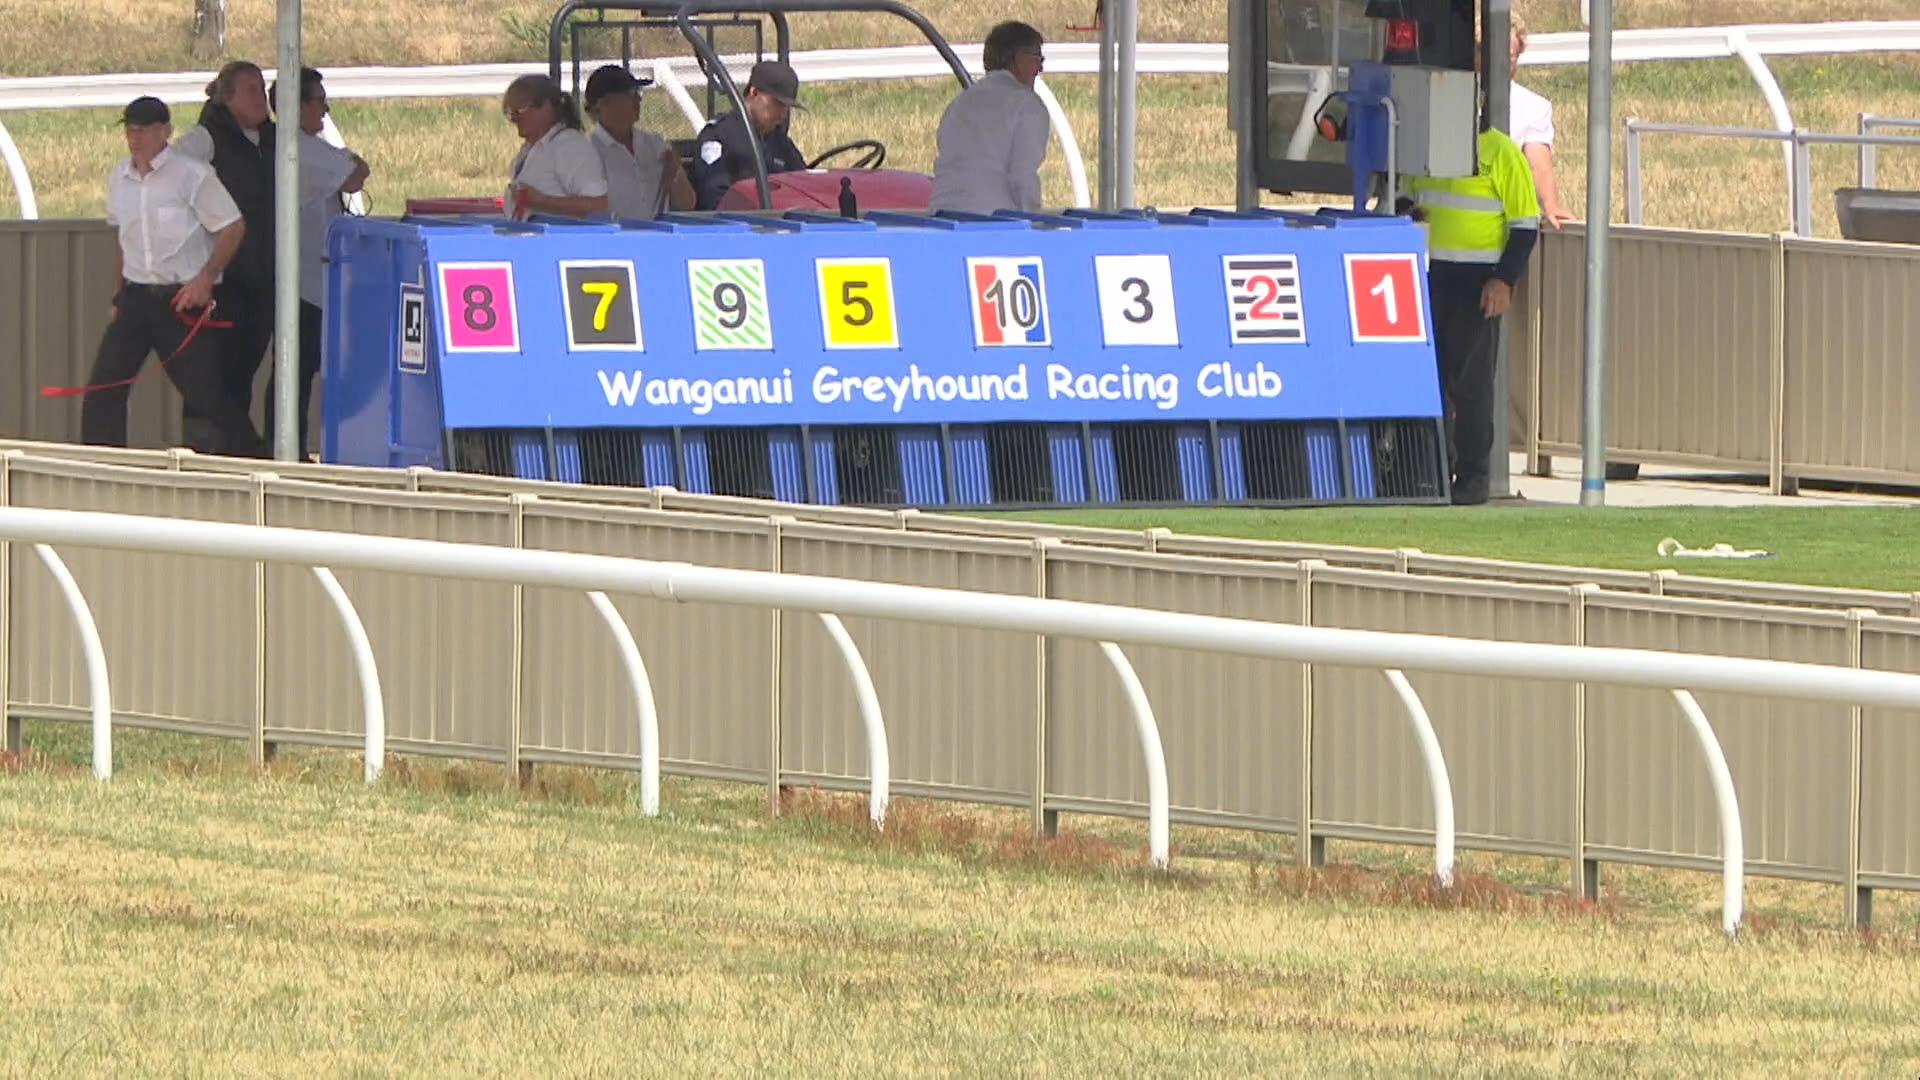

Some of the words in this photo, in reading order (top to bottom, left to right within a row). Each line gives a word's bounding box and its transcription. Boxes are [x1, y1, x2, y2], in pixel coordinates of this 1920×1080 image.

[462, 284, 497, 331] 8
[580, 281, 618, 332] 7
[712, 282, 748, 329] 9
[841, 280, 875, 326] 5
[983, 277, 1039, 329] 10
[1121, 277, 1154, 324] 3
[1245, 274, 1281, 320] 2
[1370, 273, 1398, 325] 1
[597, 368, 794, 415] Wanganui
[812, 364, 1029, 412] Greyhound
[1047, 364, 1178, 410] Racing
[1197, 362, 1282, 398] Club
